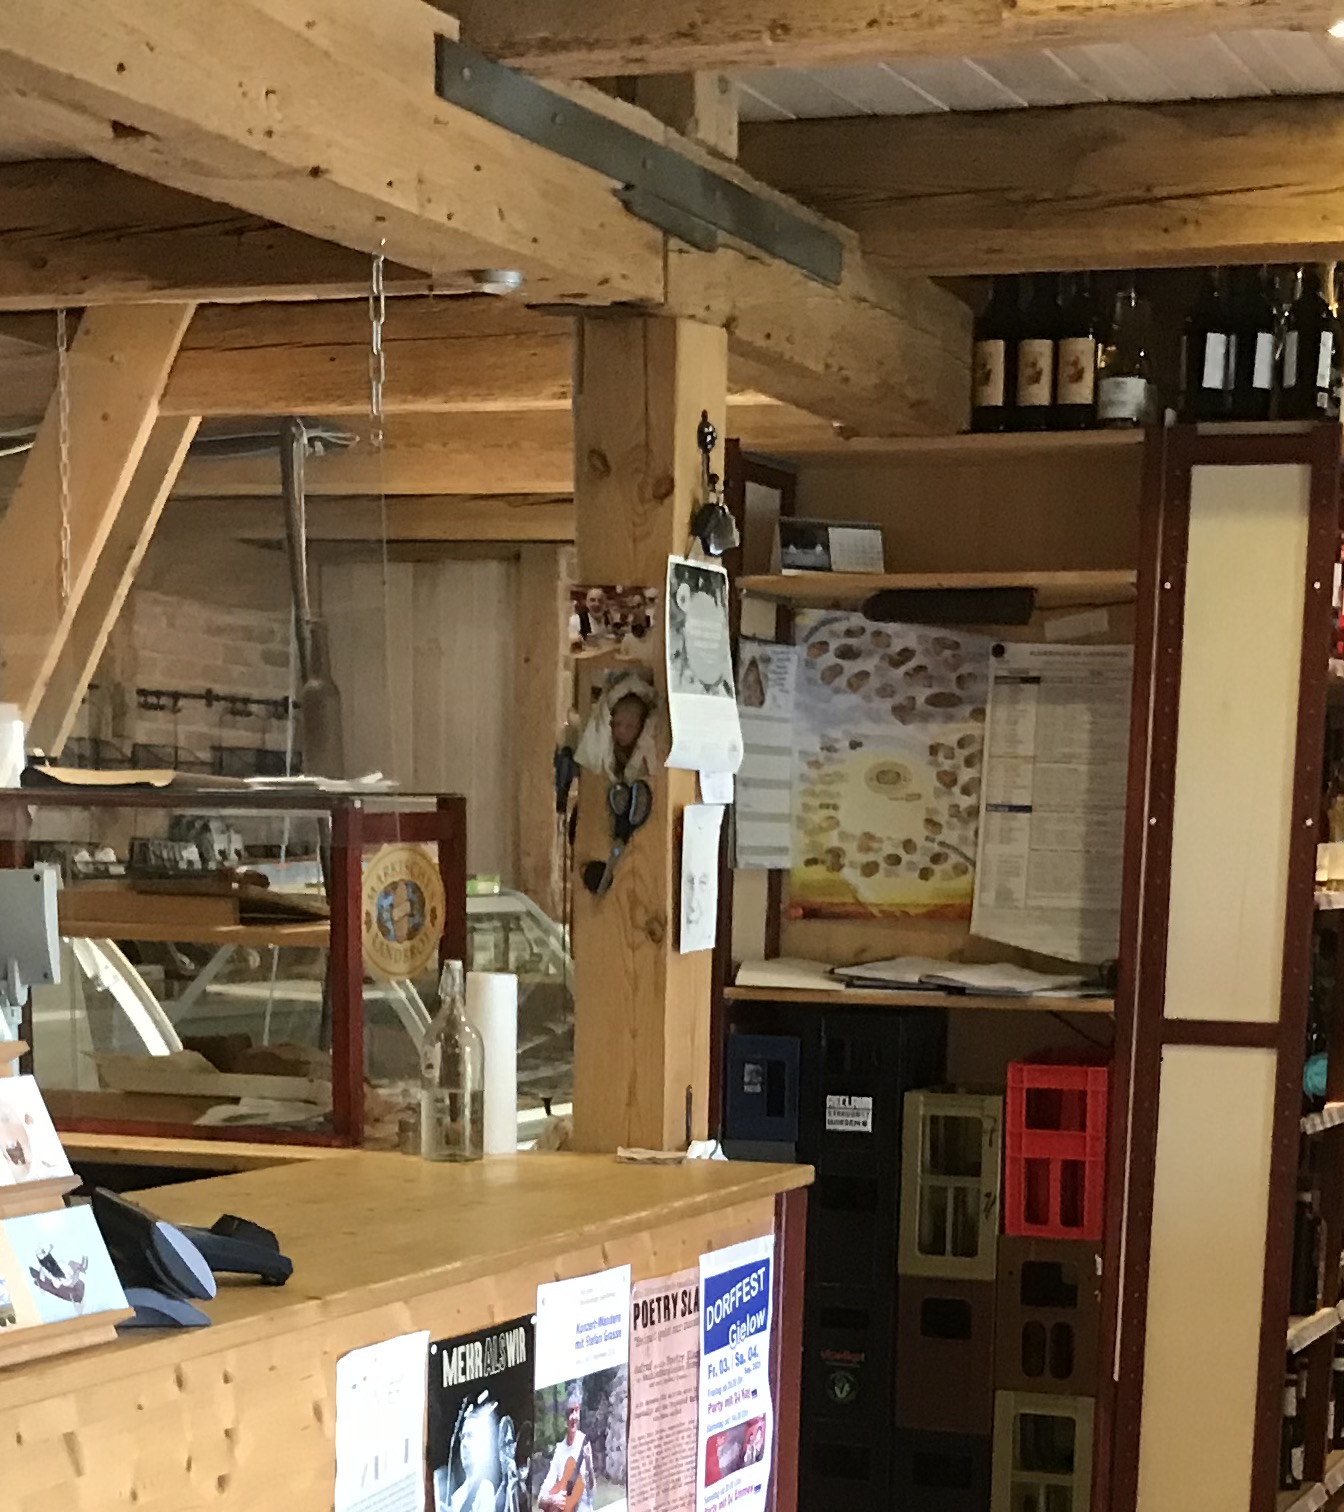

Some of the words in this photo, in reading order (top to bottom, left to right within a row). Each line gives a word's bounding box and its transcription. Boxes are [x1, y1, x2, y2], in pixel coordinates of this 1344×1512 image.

[633, 1292, 678, 1331] POETRY
[681, 1285, 700, 1318] SLA
[706, 1266, 766, 1331] DORFFEST
[728, 1307, 766, 1350] Gielow
[707, 1363, 718, 1380] Fr.
[719, 1357, 730, 1375] 03.
[734, 1351, 746, 1367] Sa.
[747, 1344, 760, 1362] 04.
